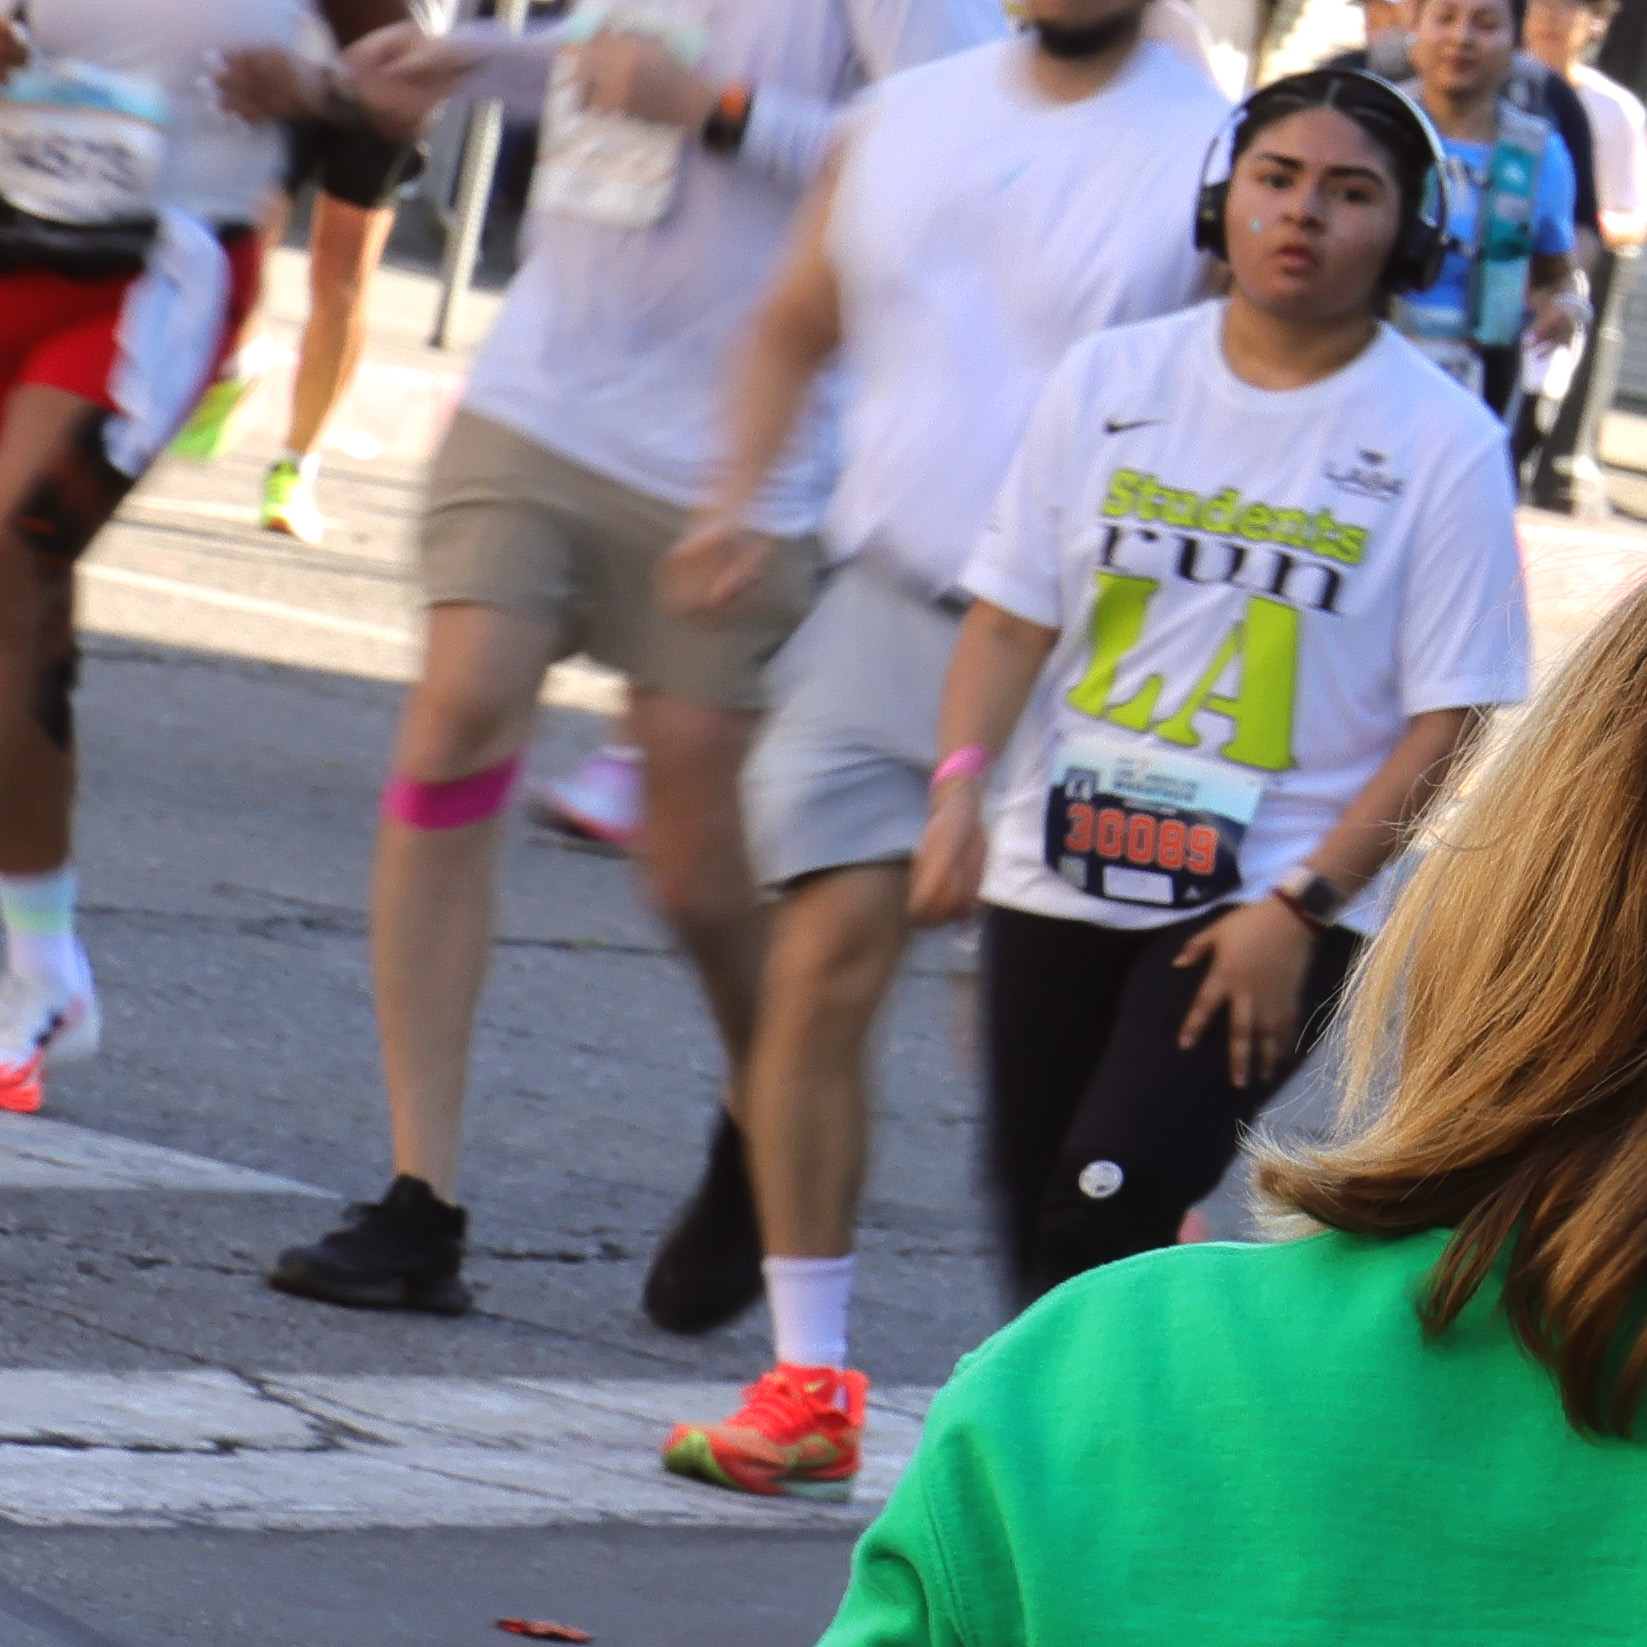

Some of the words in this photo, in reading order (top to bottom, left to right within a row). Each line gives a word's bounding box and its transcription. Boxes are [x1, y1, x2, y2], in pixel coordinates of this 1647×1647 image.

[1103, 468, 1369, 566] Students
[1101, 524, 1347, 615] run
[1066, 571, 1300, 772] LA
[1064, 802, 1219, 876] 30089
